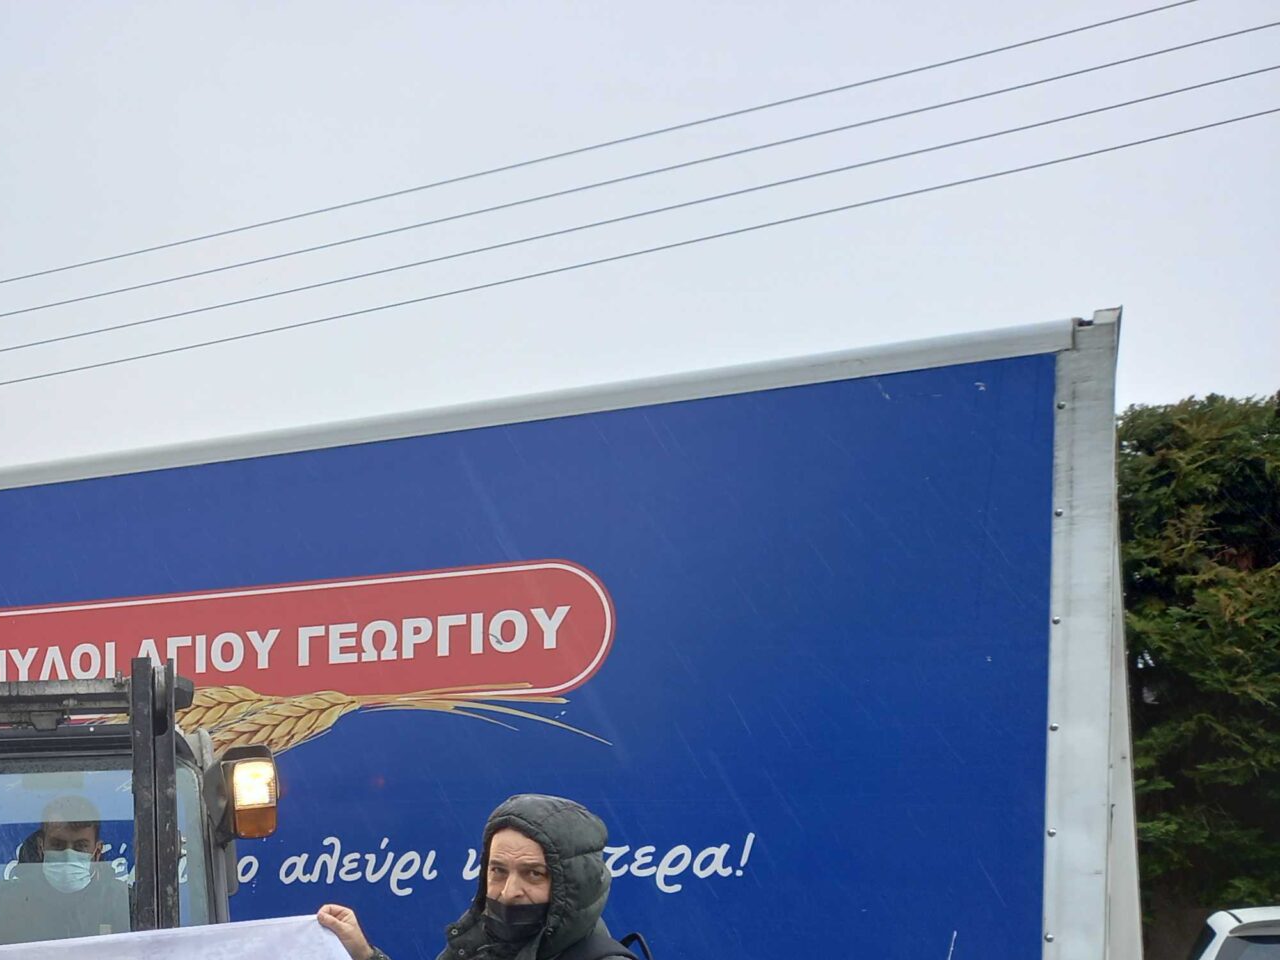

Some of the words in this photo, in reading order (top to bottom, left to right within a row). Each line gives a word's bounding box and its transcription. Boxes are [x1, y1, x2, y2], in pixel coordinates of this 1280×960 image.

[135, 629, 281, 673] ΑΓΙΟΥ
[297, 606, 572, 667] ΓΕΩΡΓΙΟΥ
[279, 836, 438, 896] αλεύρι
